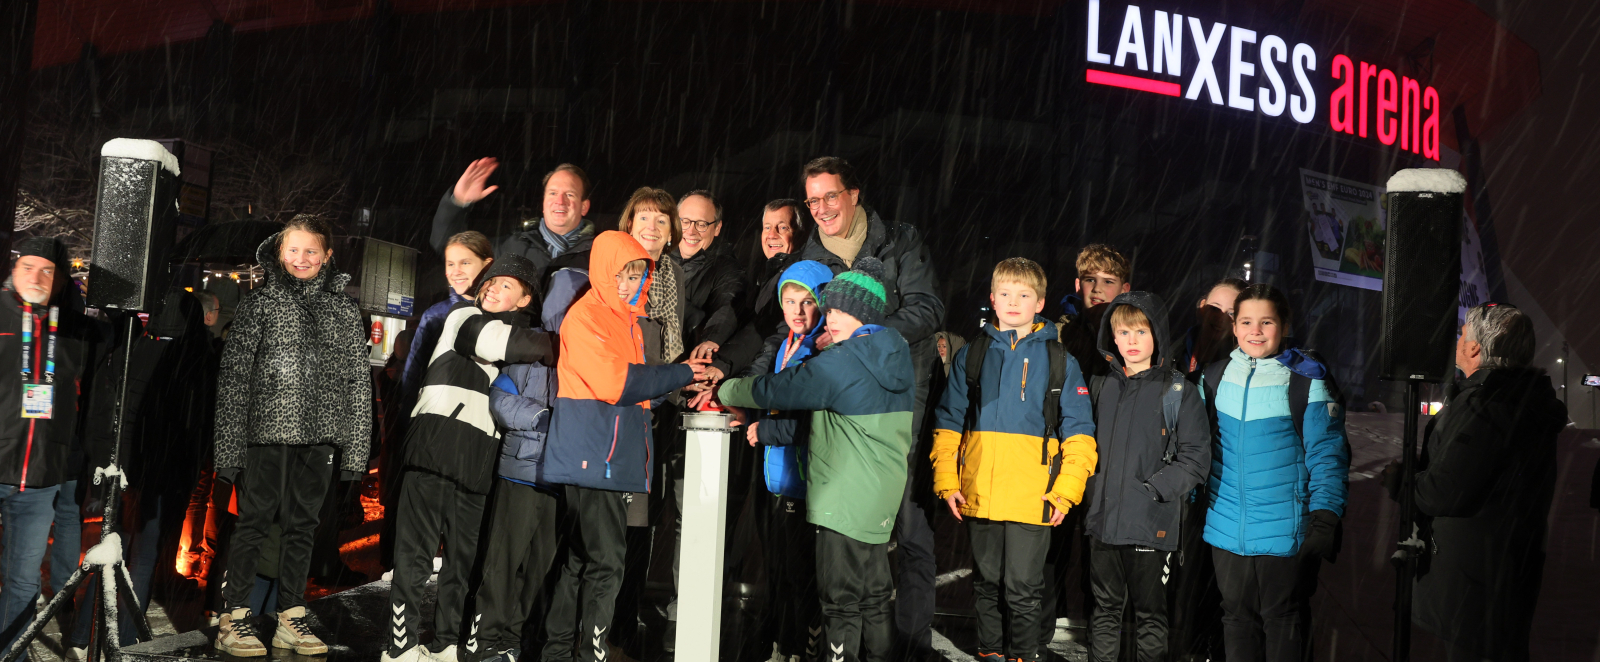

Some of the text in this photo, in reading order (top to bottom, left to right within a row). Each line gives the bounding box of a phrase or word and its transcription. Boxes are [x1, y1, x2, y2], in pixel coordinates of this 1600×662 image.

[1086, 0, 1440, 161] LANXESS arena
[1305, 176, 1326, 189] MEN'S
[1340, 185, 1358, 196] EURO
[1358, 189, 1373, 200] 2024
